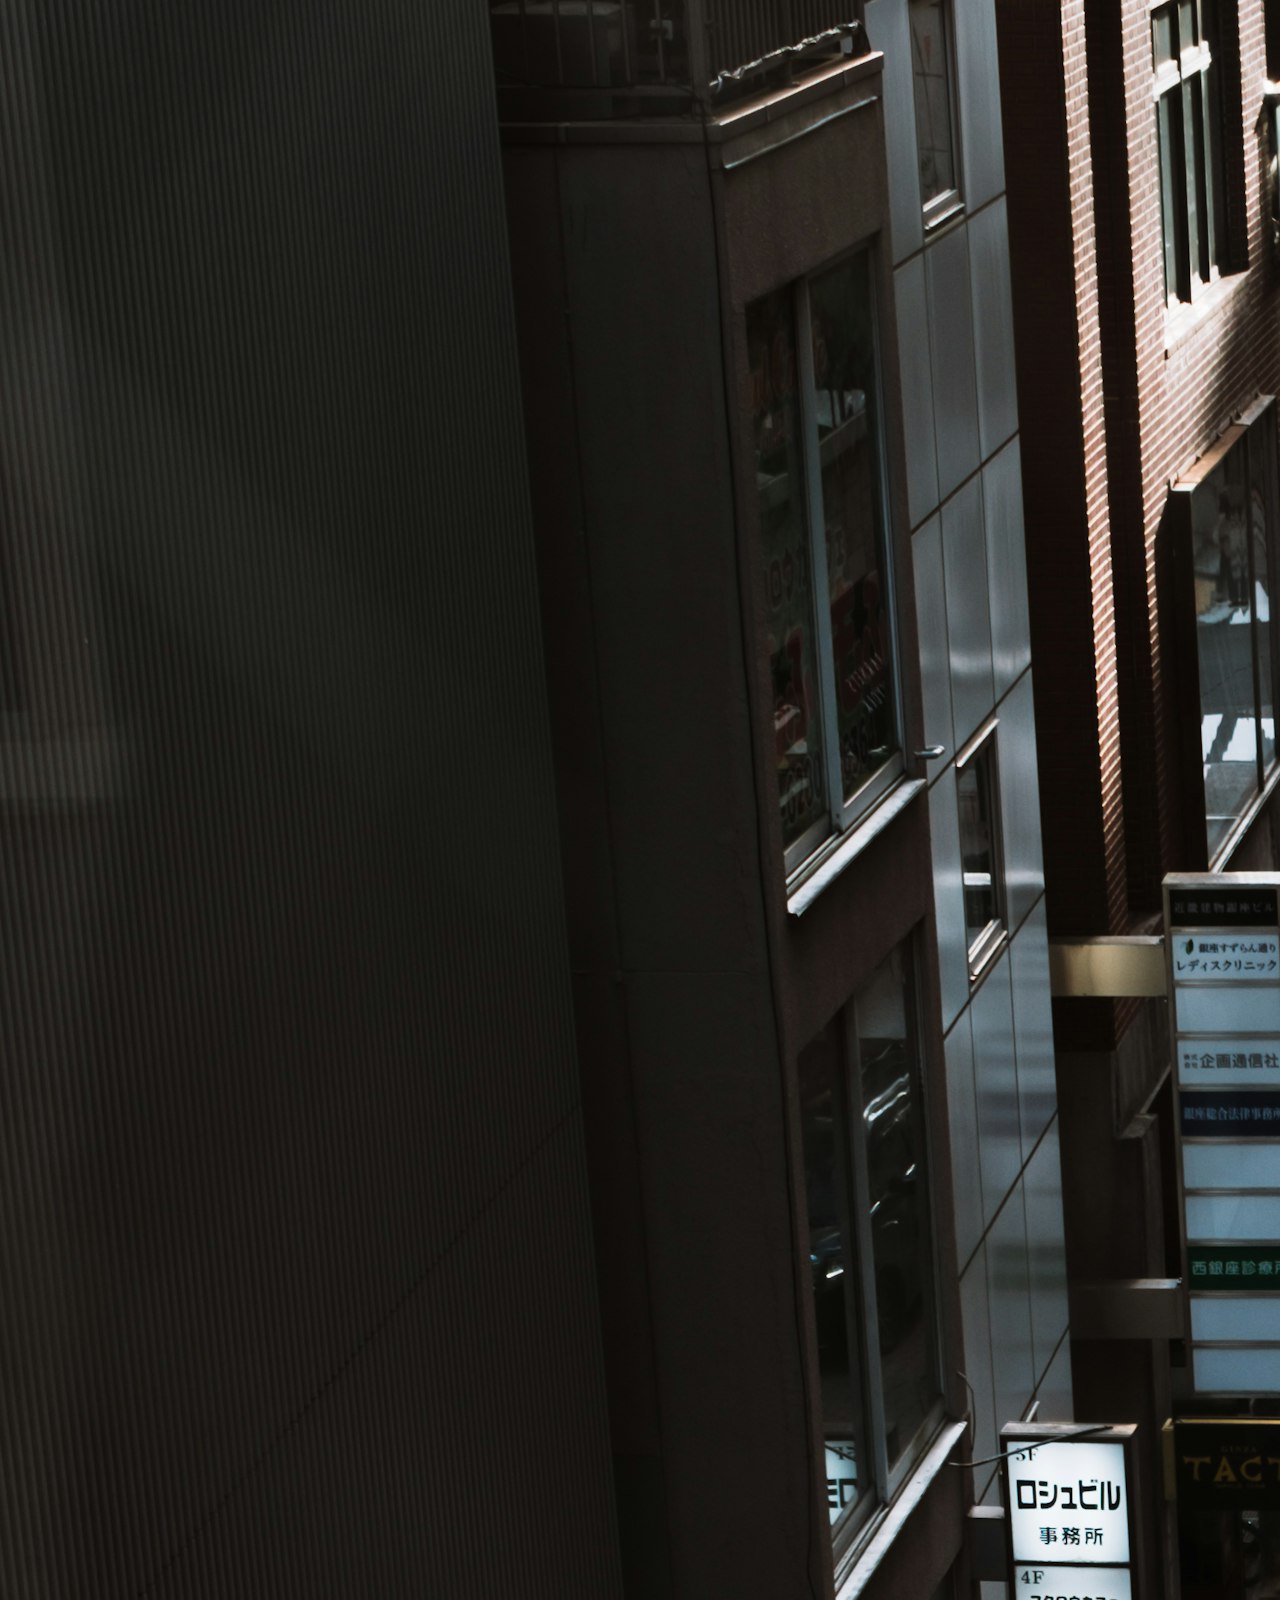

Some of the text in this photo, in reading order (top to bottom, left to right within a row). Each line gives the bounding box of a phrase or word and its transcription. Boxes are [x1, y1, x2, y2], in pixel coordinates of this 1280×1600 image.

[1199, 943, 1277, 954] 銀座すずらん通り
[1176, 959, 1277, 972] レディスクリニック
[1016, 1479, 1121, 1510] ロシュビル
[1039, 1526, 1104, 1546] 事務所
[1020, 1570, 1045, 1584] 4F
